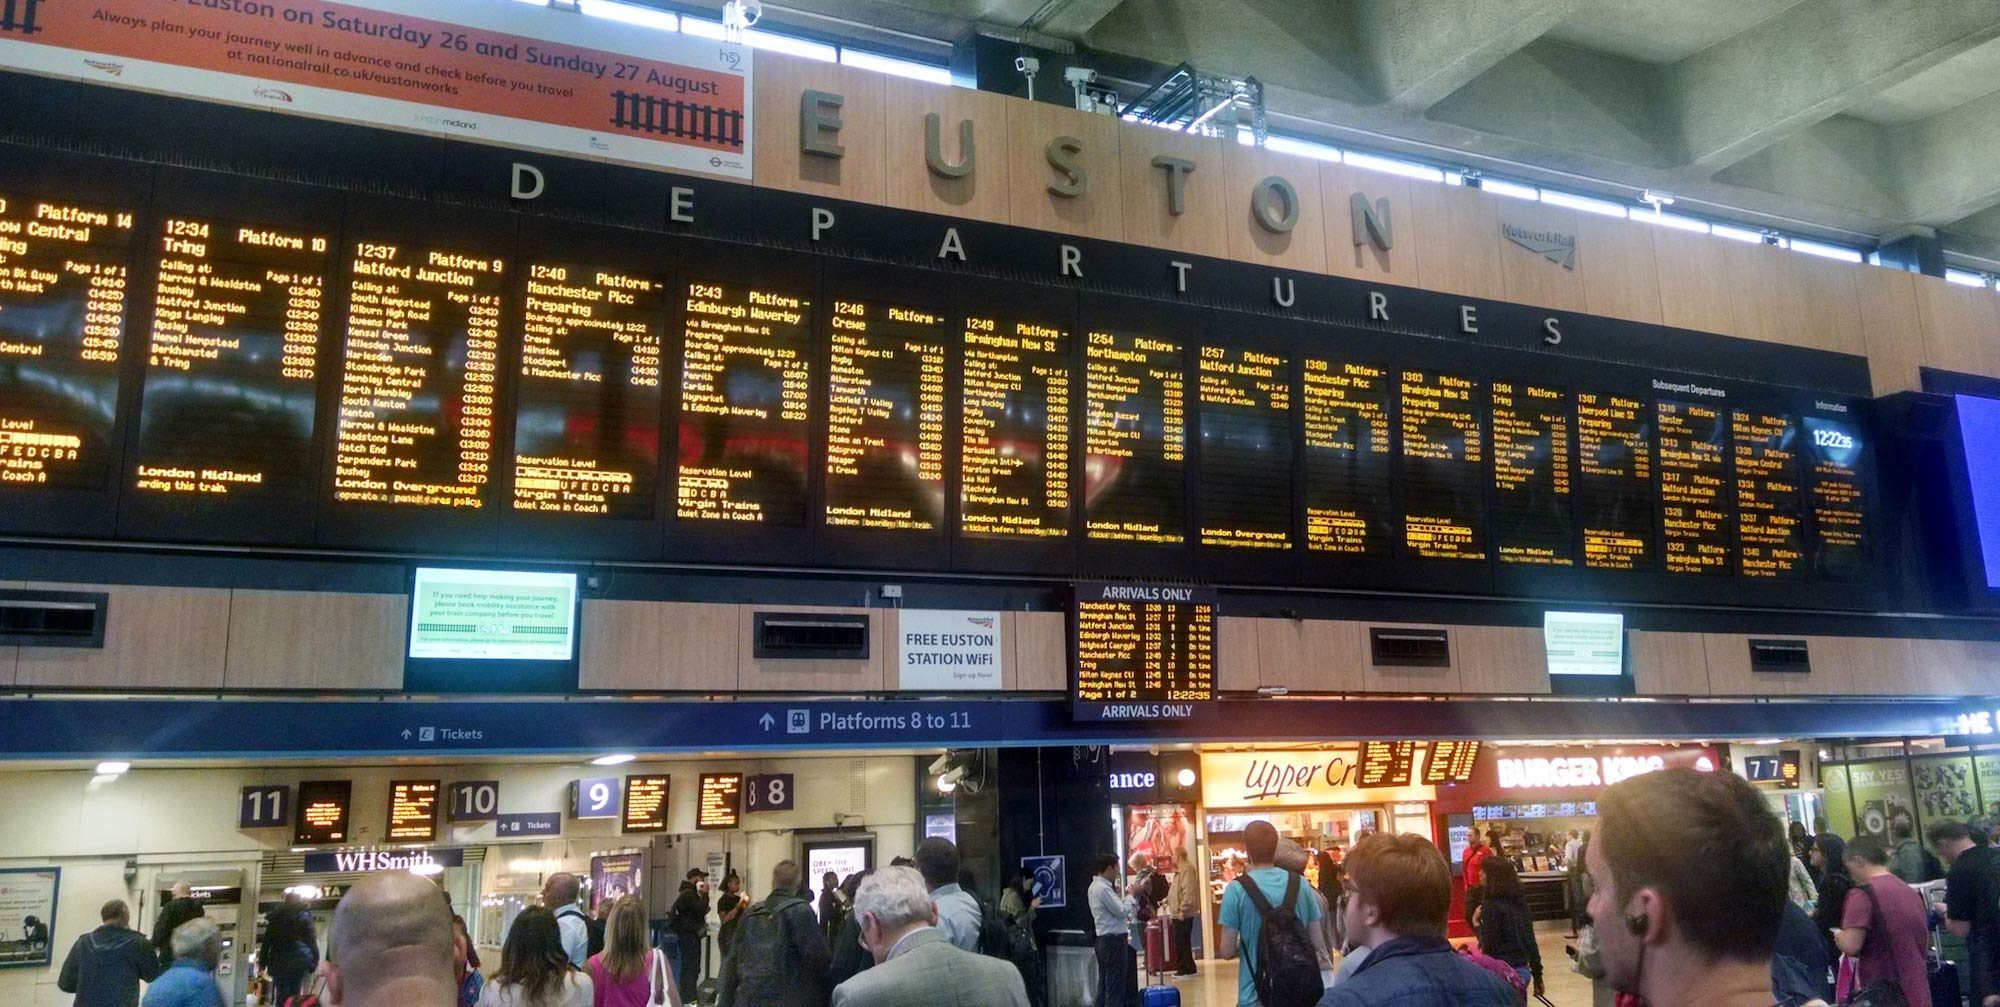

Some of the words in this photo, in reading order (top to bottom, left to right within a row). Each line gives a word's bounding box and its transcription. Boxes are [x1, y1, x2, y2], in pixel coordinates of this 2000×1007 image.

[92, 9, 147, 28] Always
[151, 19, 183, 33] plan
[188, 27, 221, 40] your
[224, 31, 281, 51] journey
[285, 41, 313, 55] well
[316, 44, 329, 57] in
[333, 50, 391, 68] advance
[395, 59, 420, 72] and
[424, 64, 461, 79] check
[465, 71, 506, 87] before
[511, 80, 533, 92] you
[537, 82, 573, 98] travel
[188, 0, 275, 18] uston
[283, 7, 313, 25] on
[322, 10, 432, 48] Saturday
[440, 31, 468, 51] 26
[475, 41, 517, 60] and
[526, 46, 607, 80] Sunday
[614, 63, 640, 81] 27
[646, 68, 719, 95] August
[227, 50, 243, 60] at
[247, 52, 459, 95] nationalrail.co.uk/eustonworks
[801, 88, 1392, 252] EUSTON
[37, 204, 107, 224] Platform
[116, 213, 131, 228] 14
[27, 221, 89, 241] Central
[167, 220, 208, 237] 12:34
[164, 237, 204, 256] Tring
[239, 229, 302, 248] Platform
[312, 238, 325, 251] 10
[358, 243, 395, 258] 12:37
[511, 162, 1562, 344] DEPARTURES
[429, 252, 487, 270] Platform
[493, 259, 502, 272] 9
[354, 260, 410, 277] Watford
[416, 268, 473, 285] Junction
[531, 265, 565, 279] 12:40
[596, 273, 649, 289] Platform
[158, 283, 193, 297] Bushey
[528, 281, 601, 299] Manchester
[608, 290, 633, 303] Picc
[690, 284, 721, 298] 12:43
[156, 296, 199, 308] Watford
[203, 300, 245, 312] Junction
[526, 297, 590, 316] Preparing
[749, 291, 797, 307] Platform
[155, 307, 181, 319] Kings
[185, 310, 224, 324] Langley
[687, 299, 745, 317] Edinburgh
[751, 307, 800, 323] Waverley
[835, 302, 863, 315] 12:46
[889, 308, 933, 323] Platform
[832, 316, 865, 330] Crewe
[967, 318, 993, 330] 12:49
[1017, 324, 1057, 337] Platform
[965, 332, 1017, 347] Birmingham
[1021, 338, 1040, 349] New
[1044, 341, 1055, 351] St
[1088, 332, 1113, 344] 12:54
[1135, 338, 1172, 351] Platform
[1087, 346, 1145, 361] Northampton
[1201, 347, 1223, 357] 12:57
[1244, 352, 1279, 364] Platform
[1200, 360, 1233, 372] Watford
[1237, 364, 1271, 376] Junction
[1345, 364, 1378, 376] Platform
[1304, 372, 1349, 385] Manchester
[1353, 377, 1369, 387] Picc
[1439, 376, 1470, 387] Platform
[1401, 384, 1440, 396] Birmingham
[1443, 388, 1457, 398] New
[1460, 390, 1468, 399] St
[1652, 379, 1690, 395] Subsequent
[1691, 384, 1726, 398] Departures
[1492, 394, 1511, 405] Tring
[1611, 397, 1638, 408] Platform
[1815, 400, 1847, 412] Information
[1578, 405, 1608, 415] Liverpool
[1610, 409, 1624, 418] Lime
[1626, 411, 1634, 419] St
[339, 431, 388, 442] Headstone
[391, 434, 413, 444] Lane
[138, 465, 194, 478] London
[202, 470, 261, 482] Midland
[335, 478, 386, 488] London
[393, 481, 476, 494] Overground
[514, 489, 555, 499] Virgin
[563, 491, 604, 501] Trains
[1102, 586, 1159, 600] ARRIVALS
[1162, 588, 1193, 600] ONLY
[906, 633, 938, 646] FREE
[941, 634, 993, 646] EUSTON
[907, 652, 963, 665] STATION
[966, 653, 993, 665] WiFi
[1079, 691, 1103, 700] Page
[1107, 691, 1112, 699] 1
[1115, 691, 1126, 699] of
[1130, 691, 1137, 699] 2
[1102, 705, 1159, 718] ARRIVALS
[1162, 705, 1193, 717] ONLY
[820, 712, 906, 730] Platforms
[910, 711, 921, 729] 8
[926, 714, 945, 729] to
[949, 711, 971, 729] 11
[440, 727, 483, 740] Tickets
[1497, 758, 1600, 788] BURGER
[1751, 760, 1761, 778] 7
[1769, 759, 1778, 777] 7
[1852, 771, 1875, 783] SAY
[1879, 769, 1907, 783] YES!
[1243, 759, 1320, 800] Upper
[460, 785, 496, 814] 10
[589, 783, 609, 811] 9
[767, 779, 785, 805] 8
[247, 790, 281, 820] 11
[527, 821, 551, 830] Tickets
[336, 850, 435, 872] WHSmith
